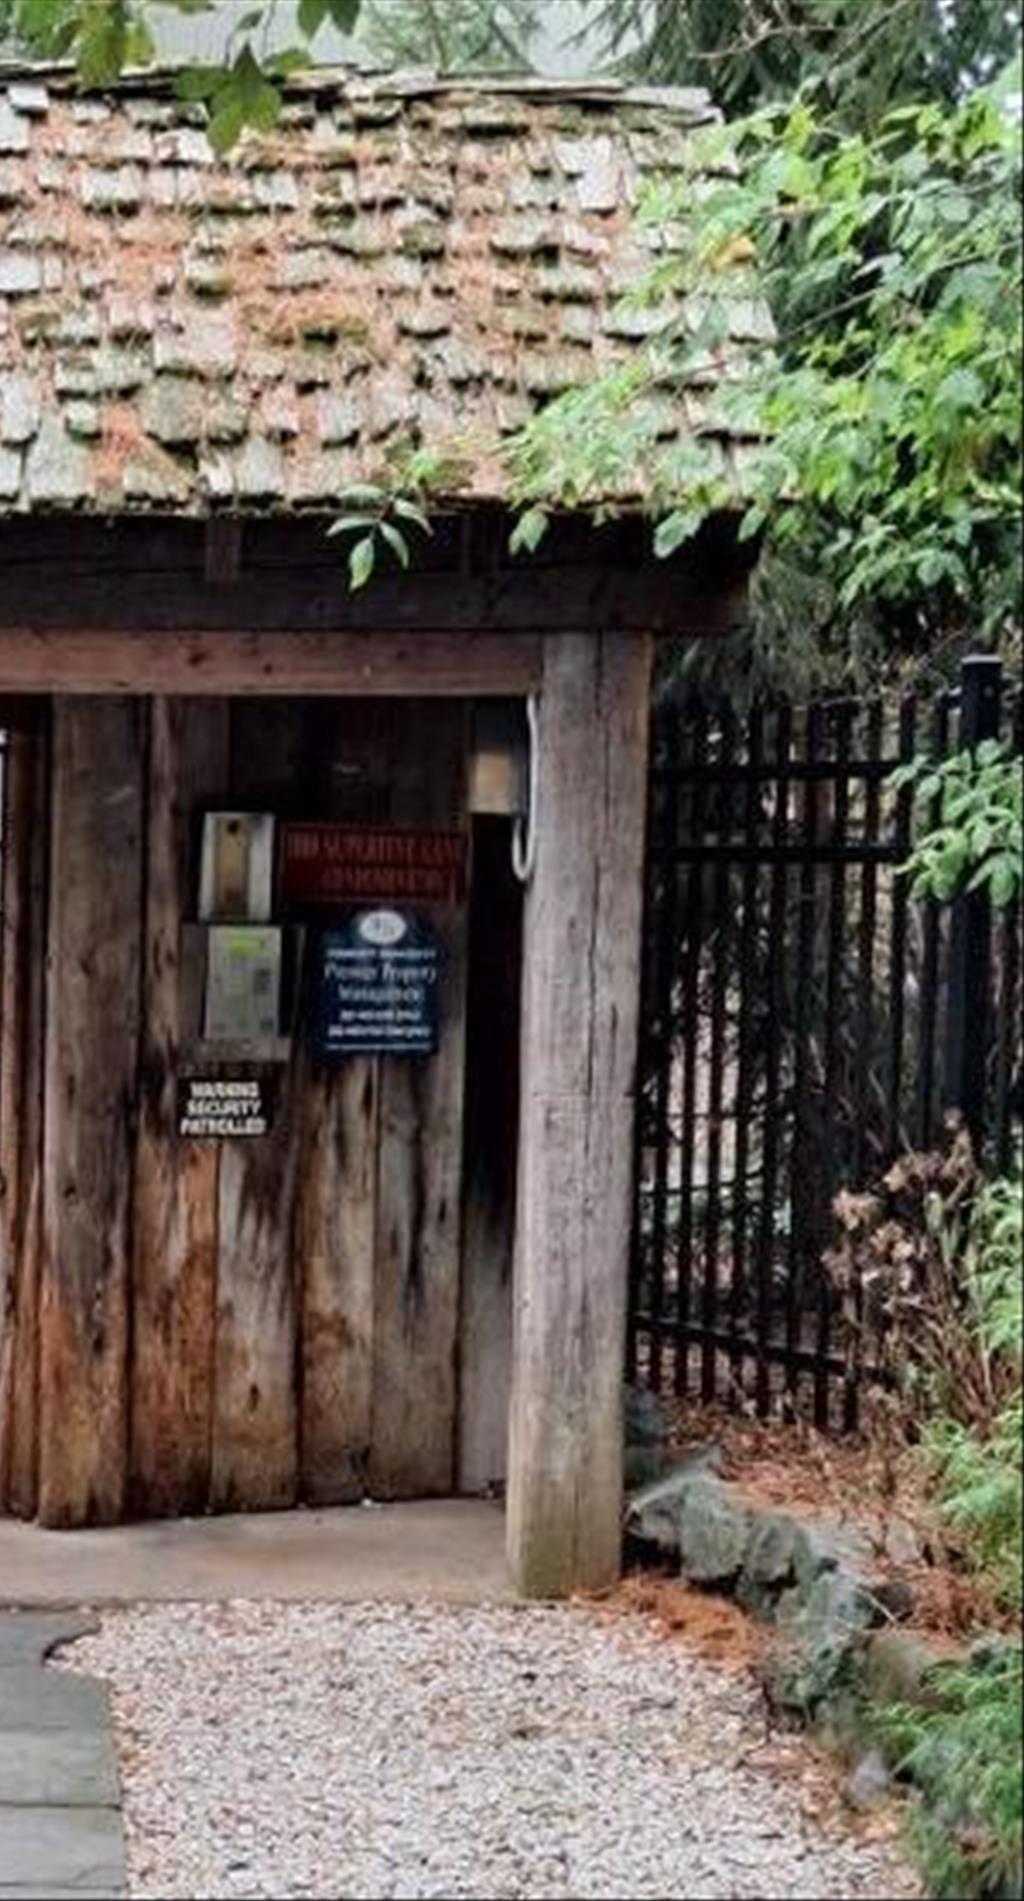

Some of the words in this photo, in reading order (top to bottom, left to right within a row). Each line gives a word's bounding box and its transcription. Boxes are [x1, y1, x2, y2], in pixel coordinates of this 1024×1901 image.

[190, 1081, 259, 1098] WARNING
[186, 1098, 262, 1116] SECURITY
[179, 1117, 267, 1136] PATROLLED
